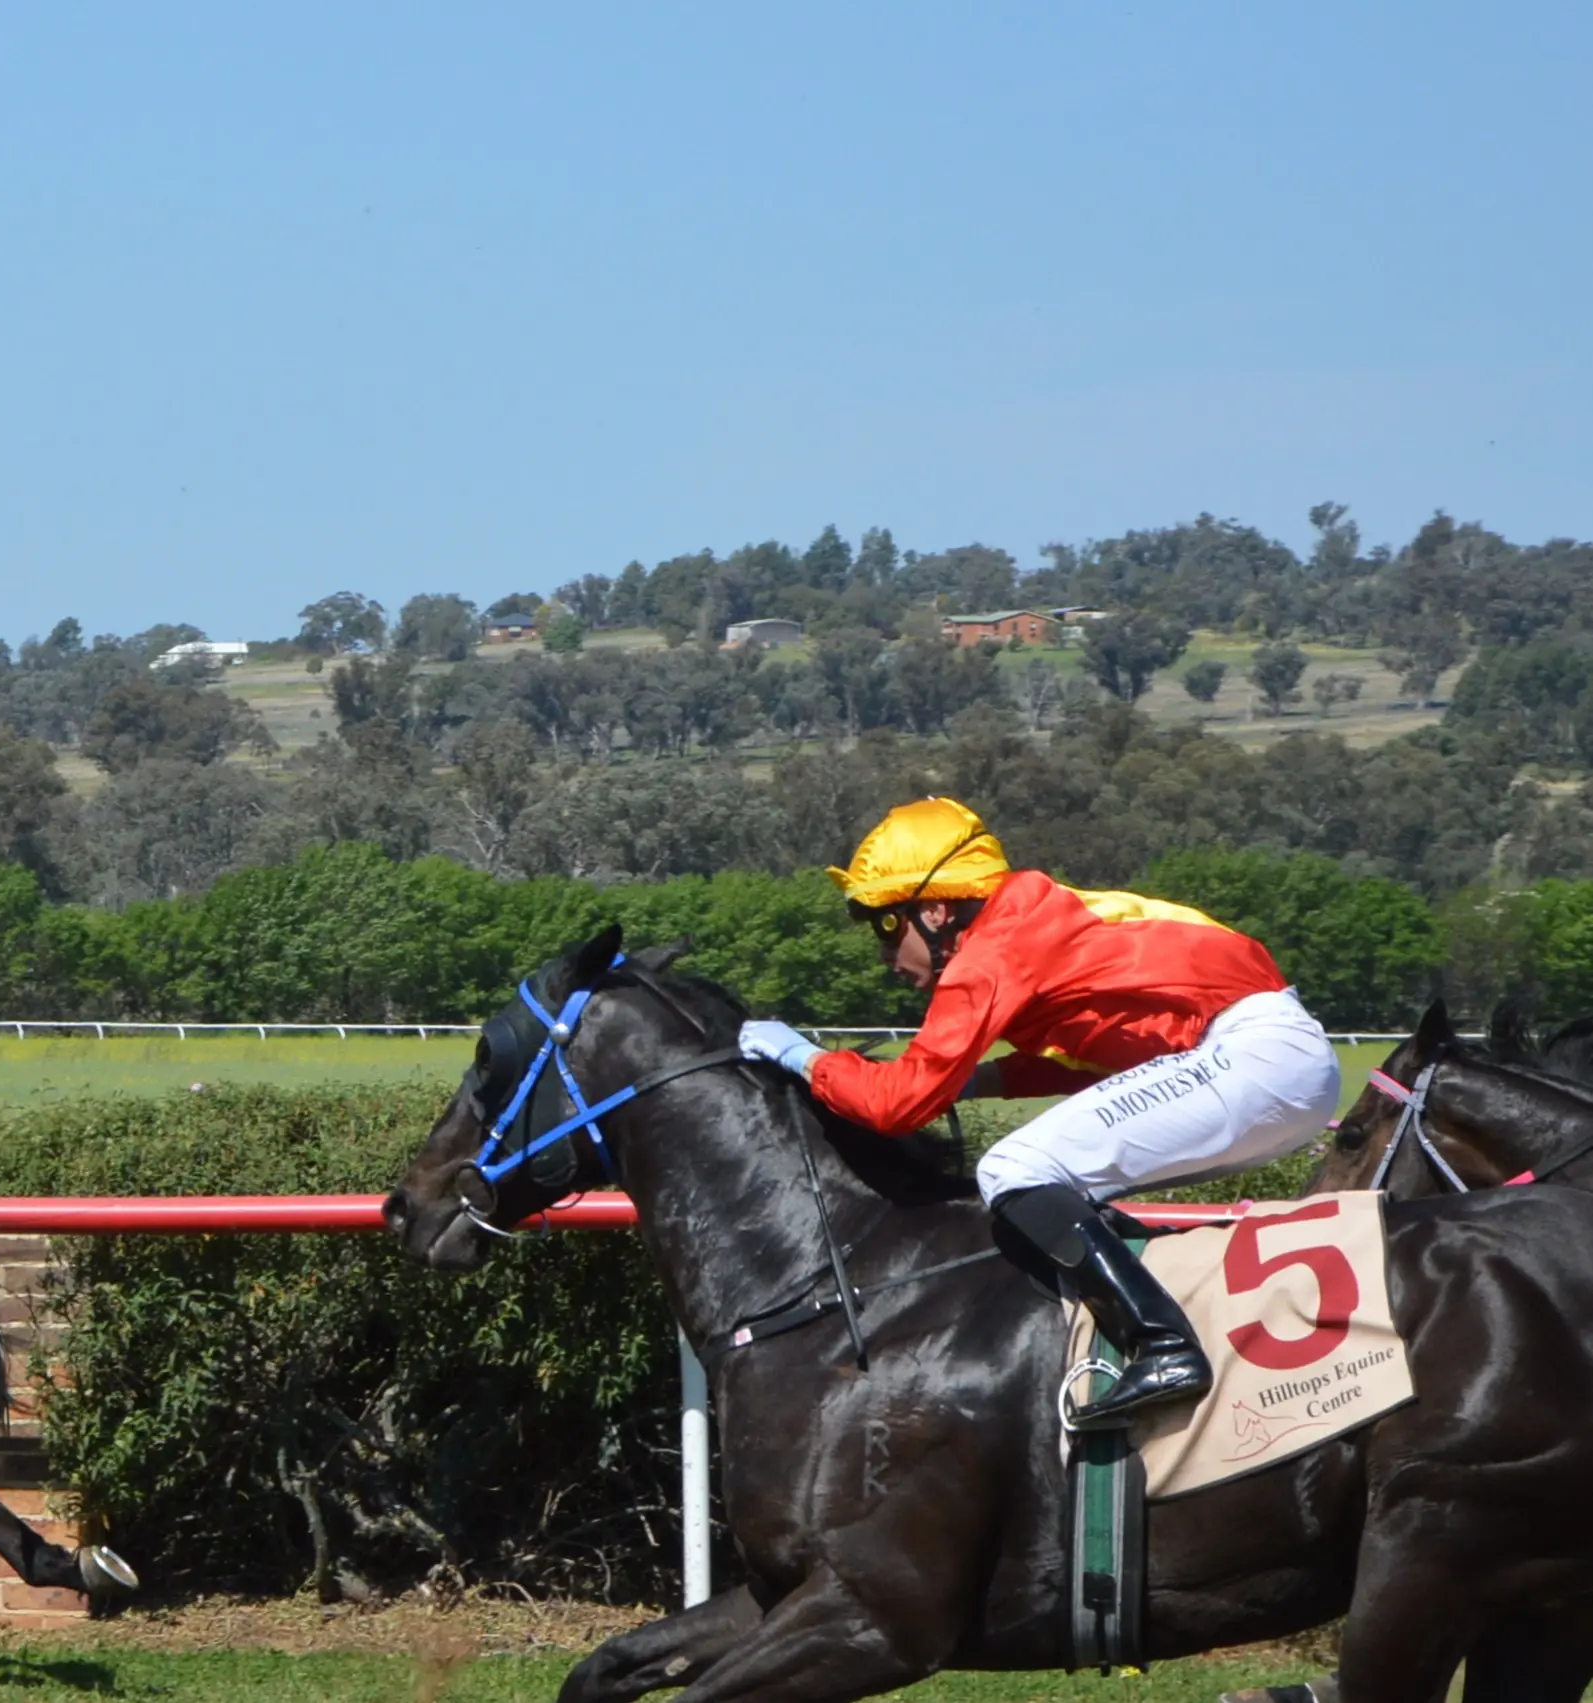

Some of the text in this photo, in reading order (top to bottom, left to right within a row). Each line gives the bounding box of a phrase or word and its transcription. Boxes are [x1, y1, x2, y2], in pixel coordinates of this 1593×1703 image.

[1224, 1200, 1359, 1370] 5
[1258, 1347, 1395, 1409] Hilltops Equine
[1306, 1384, 1363, 1419] Centre
